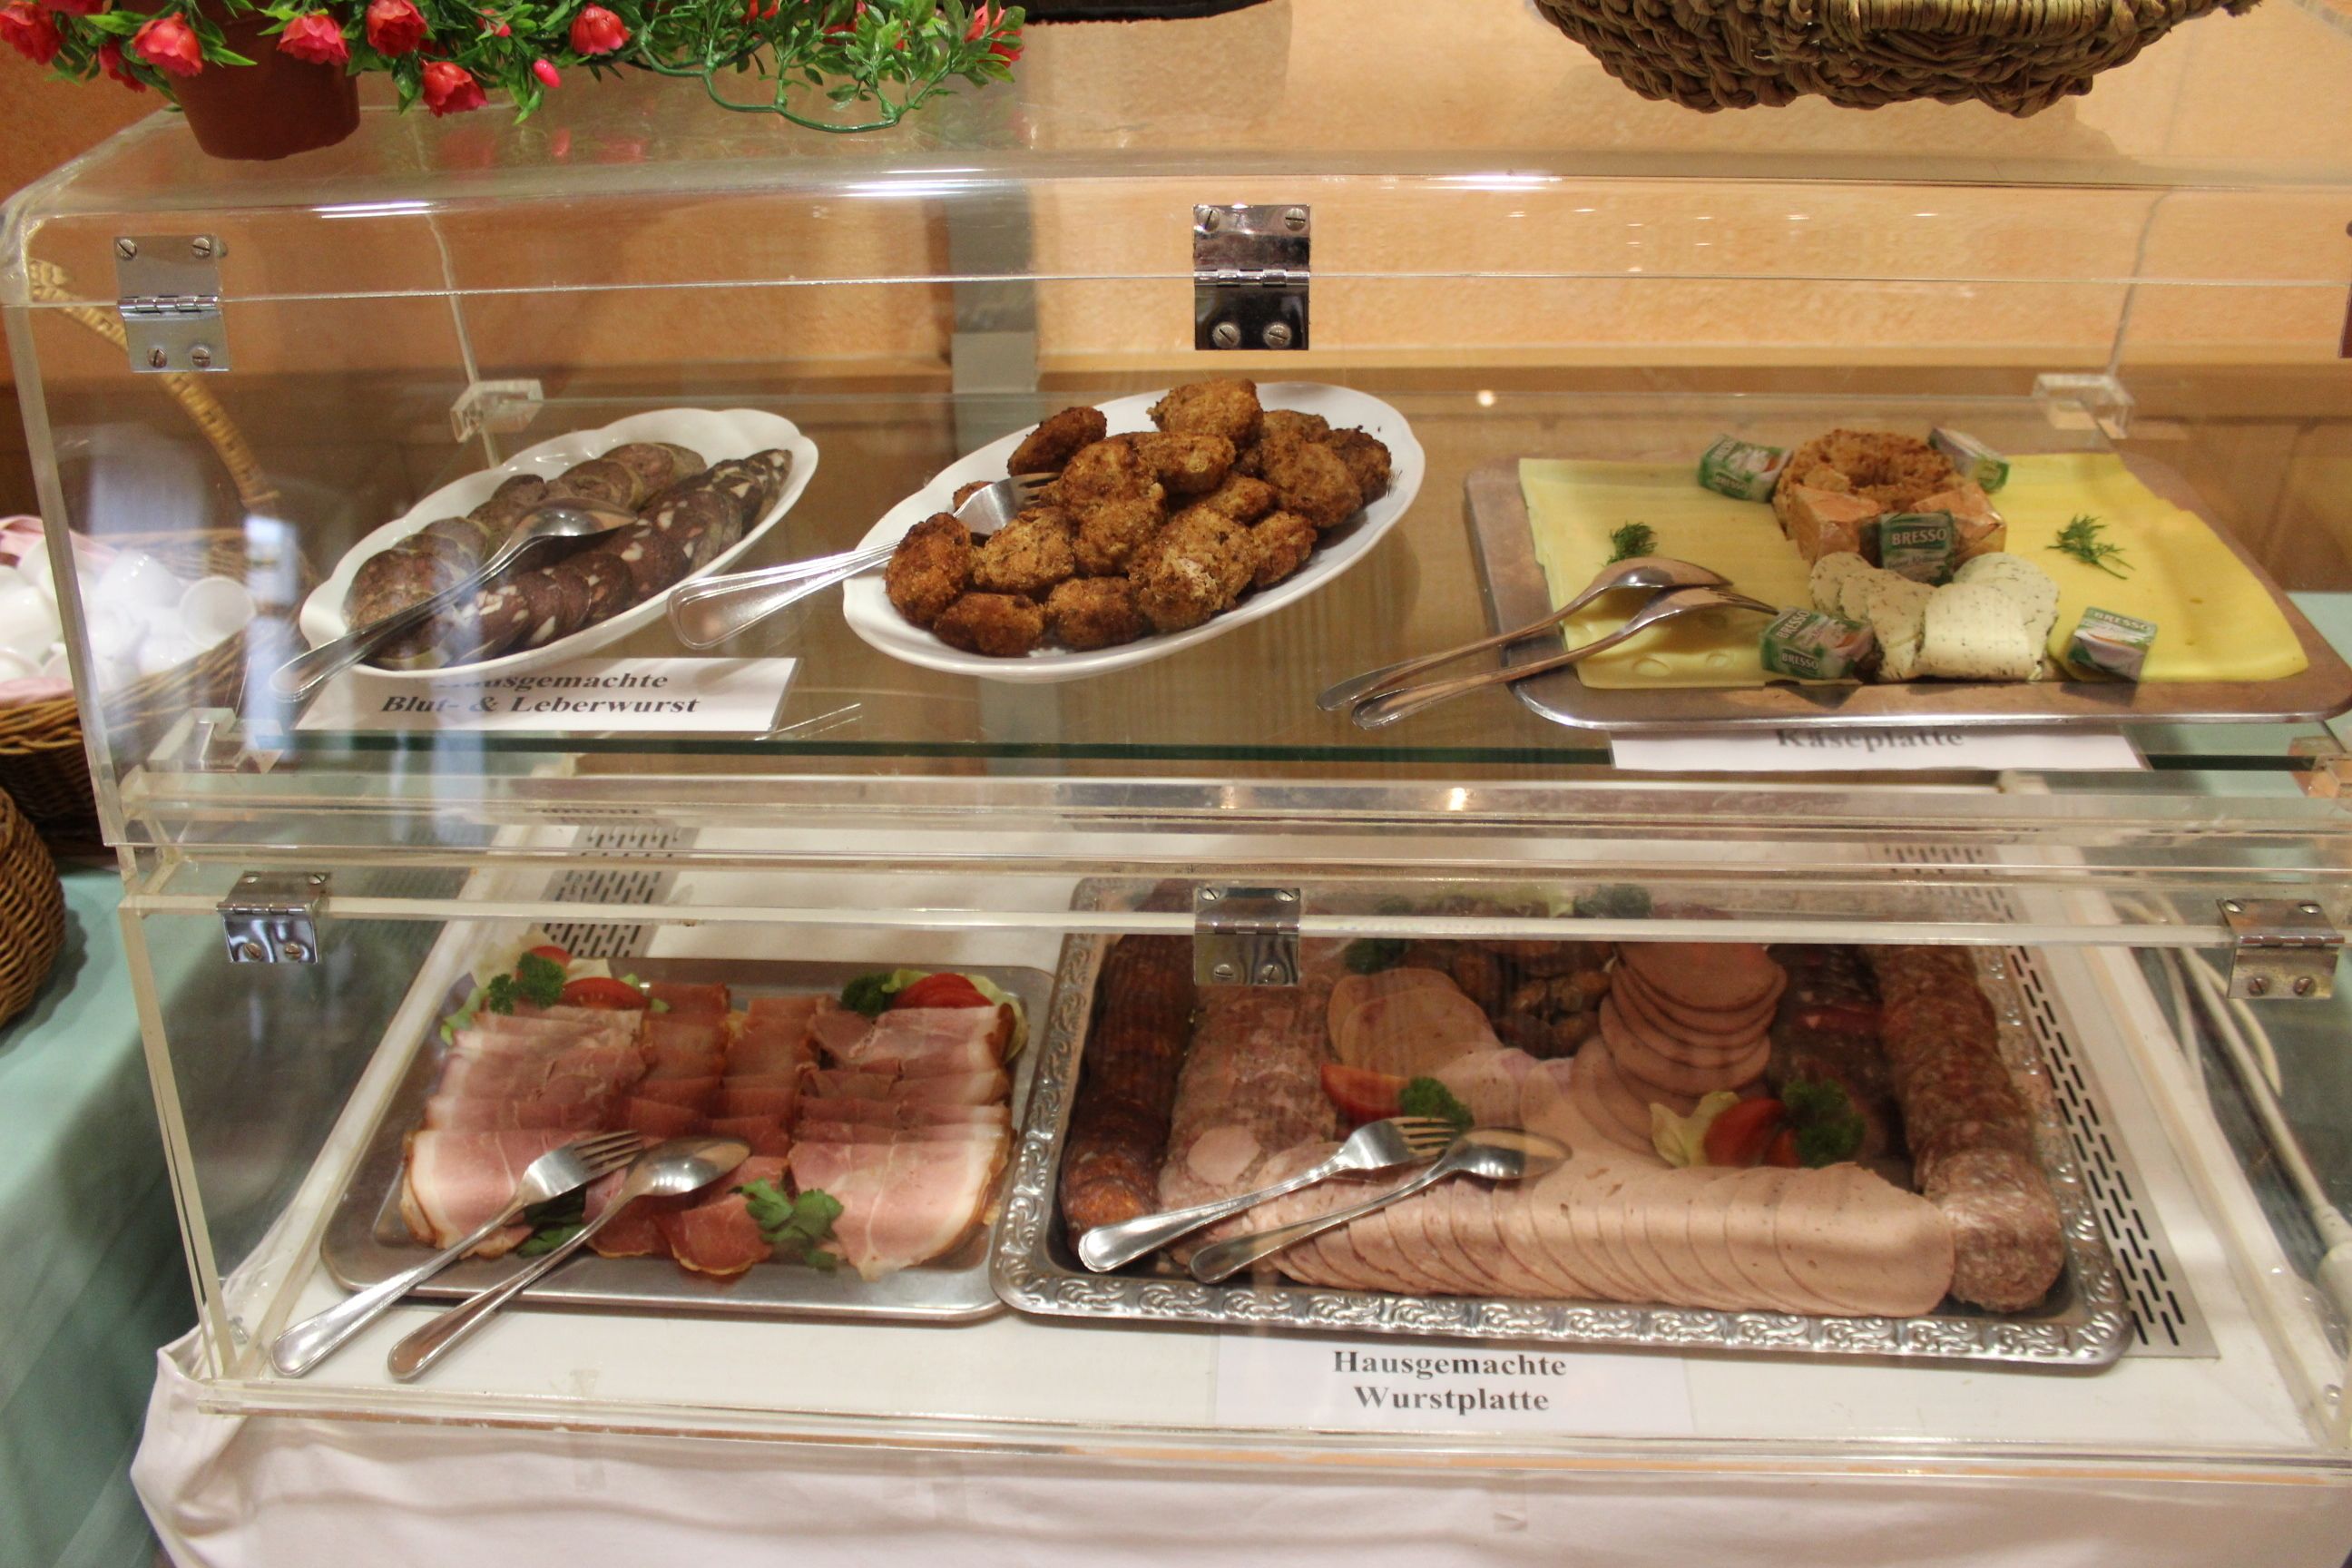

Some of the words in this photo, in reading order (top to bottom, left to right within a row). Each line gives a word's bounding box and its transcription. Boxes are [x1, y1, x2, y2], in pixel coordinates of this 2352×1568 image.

[1891, 528, 1947, 545] BRESSO
[1776, 610, 1811, 639] BRESSO
[1781, 652, 1819, 670] BRESSO
[380, 695, 459, 713] Blut-
[467, 695, 499, 713] &
[509, 696, 701, 713] Leberwurst
[1332, 1350, 1568, 1380] Hausgemachte
[1353, 1386, 1550, 1416] Wurstplatte
